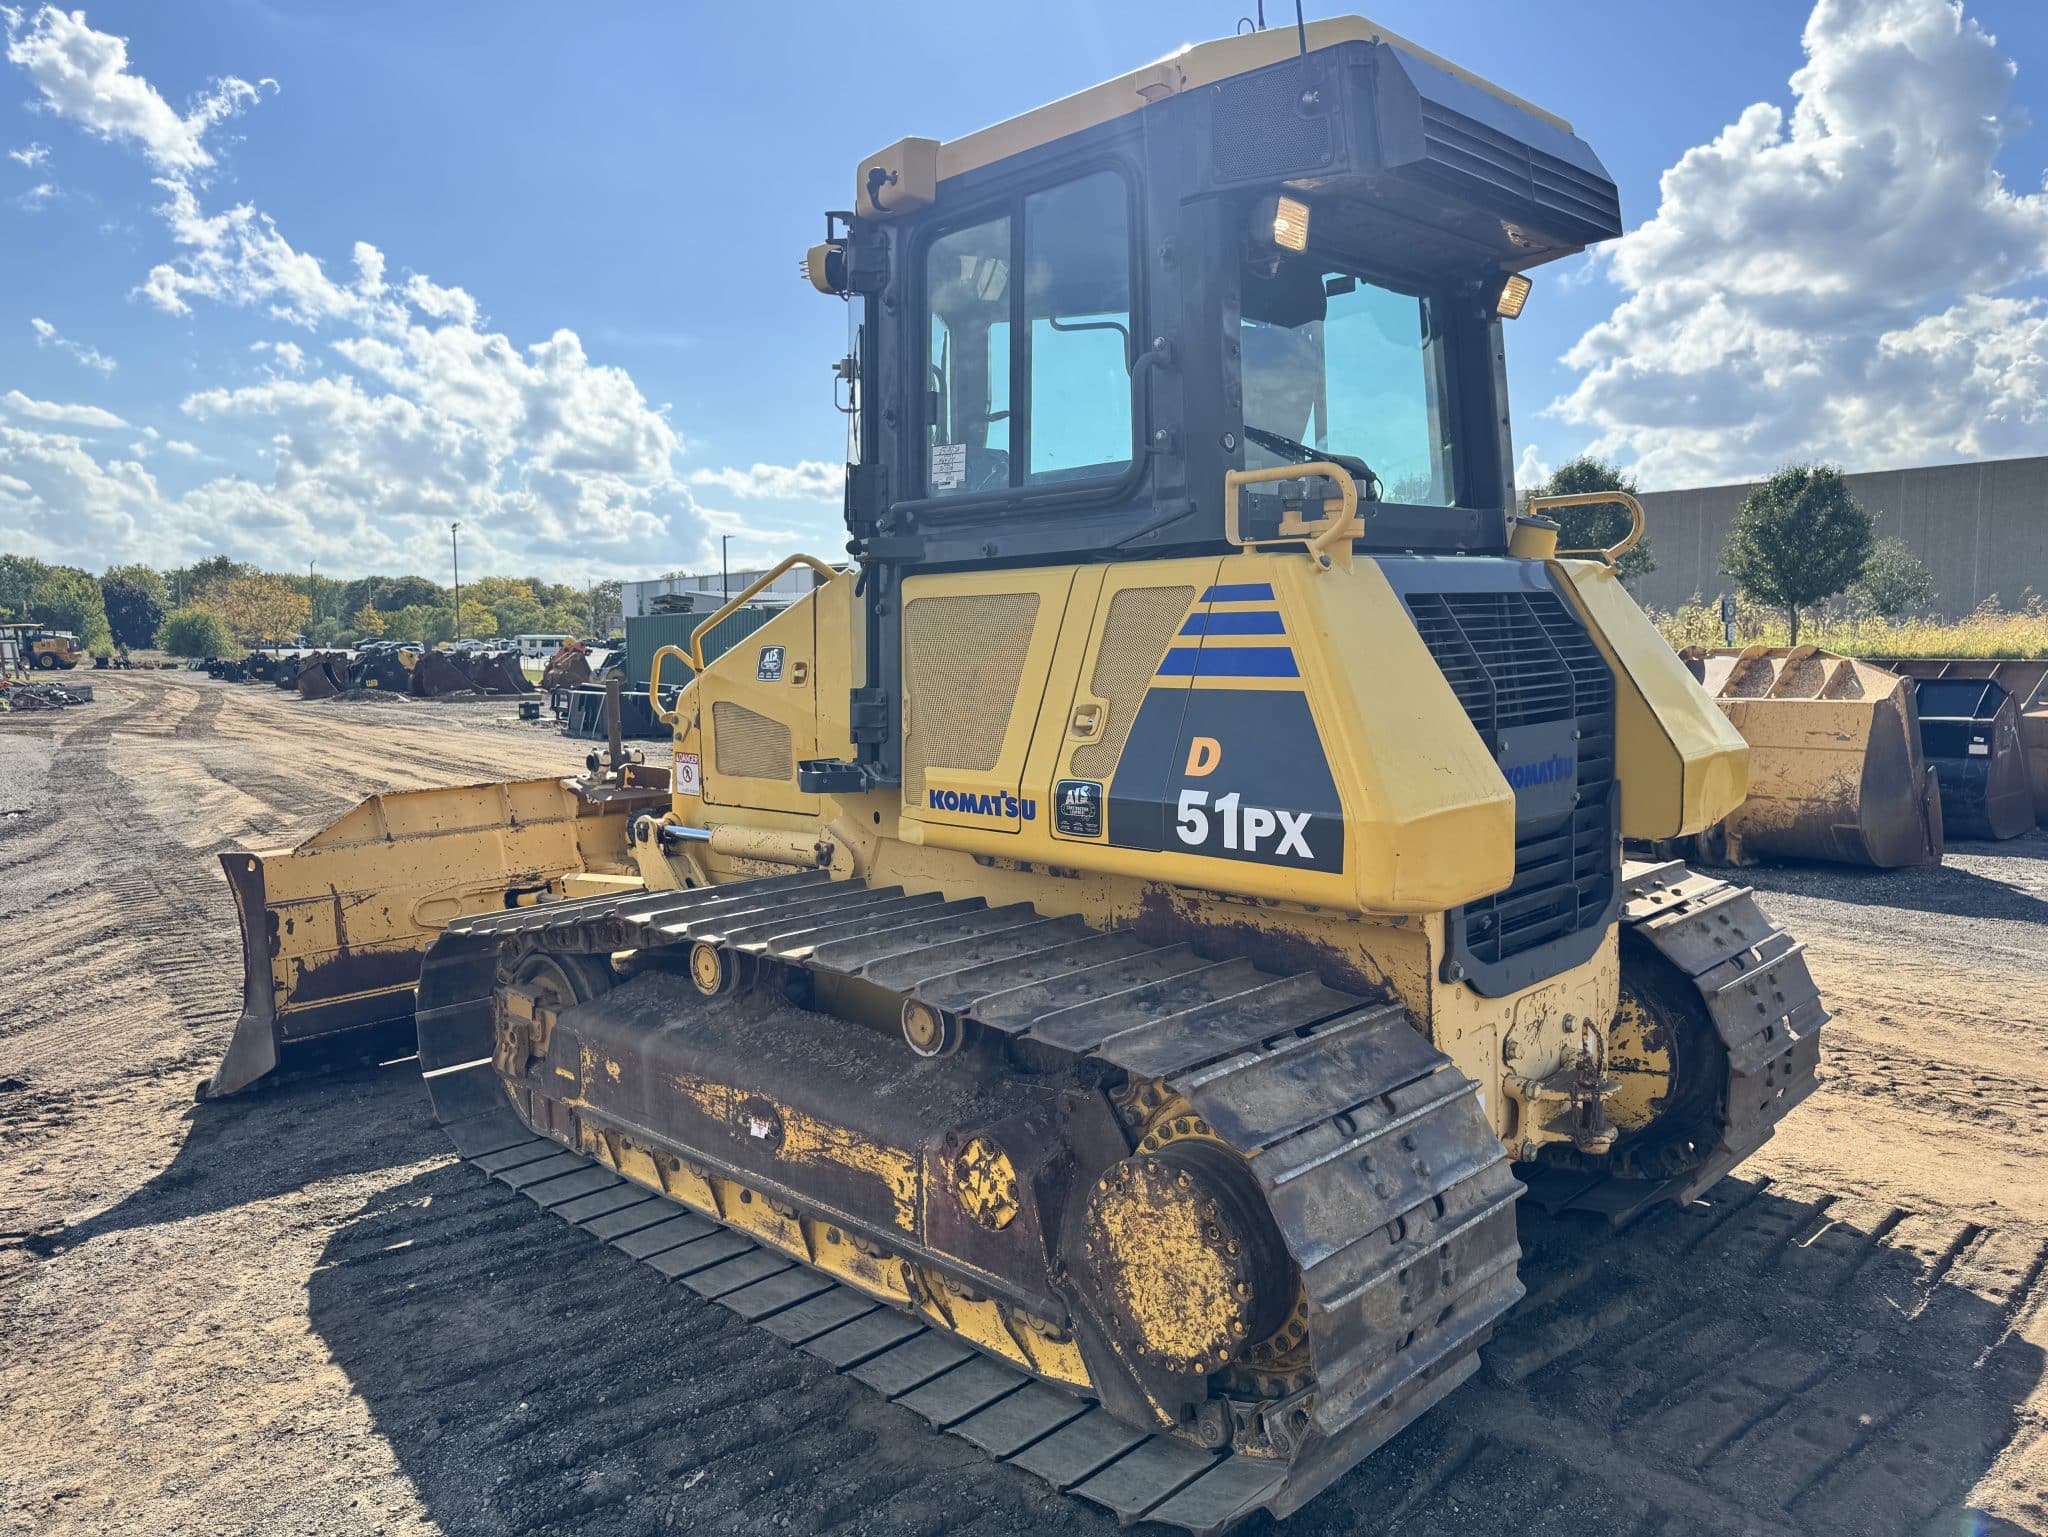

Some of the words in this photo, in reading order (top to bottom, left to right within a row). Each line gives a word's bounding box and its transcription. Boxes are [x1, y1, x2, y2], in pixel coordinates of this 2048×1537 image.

[764, 649, 779, 661] AIS
[1184, 736, 1222, 777] D
[929, 789, 1036, 821] KOMATSU
[1065, 786, 1090, 805] AIS
[1176, 789, 1315, 859] 51PX
